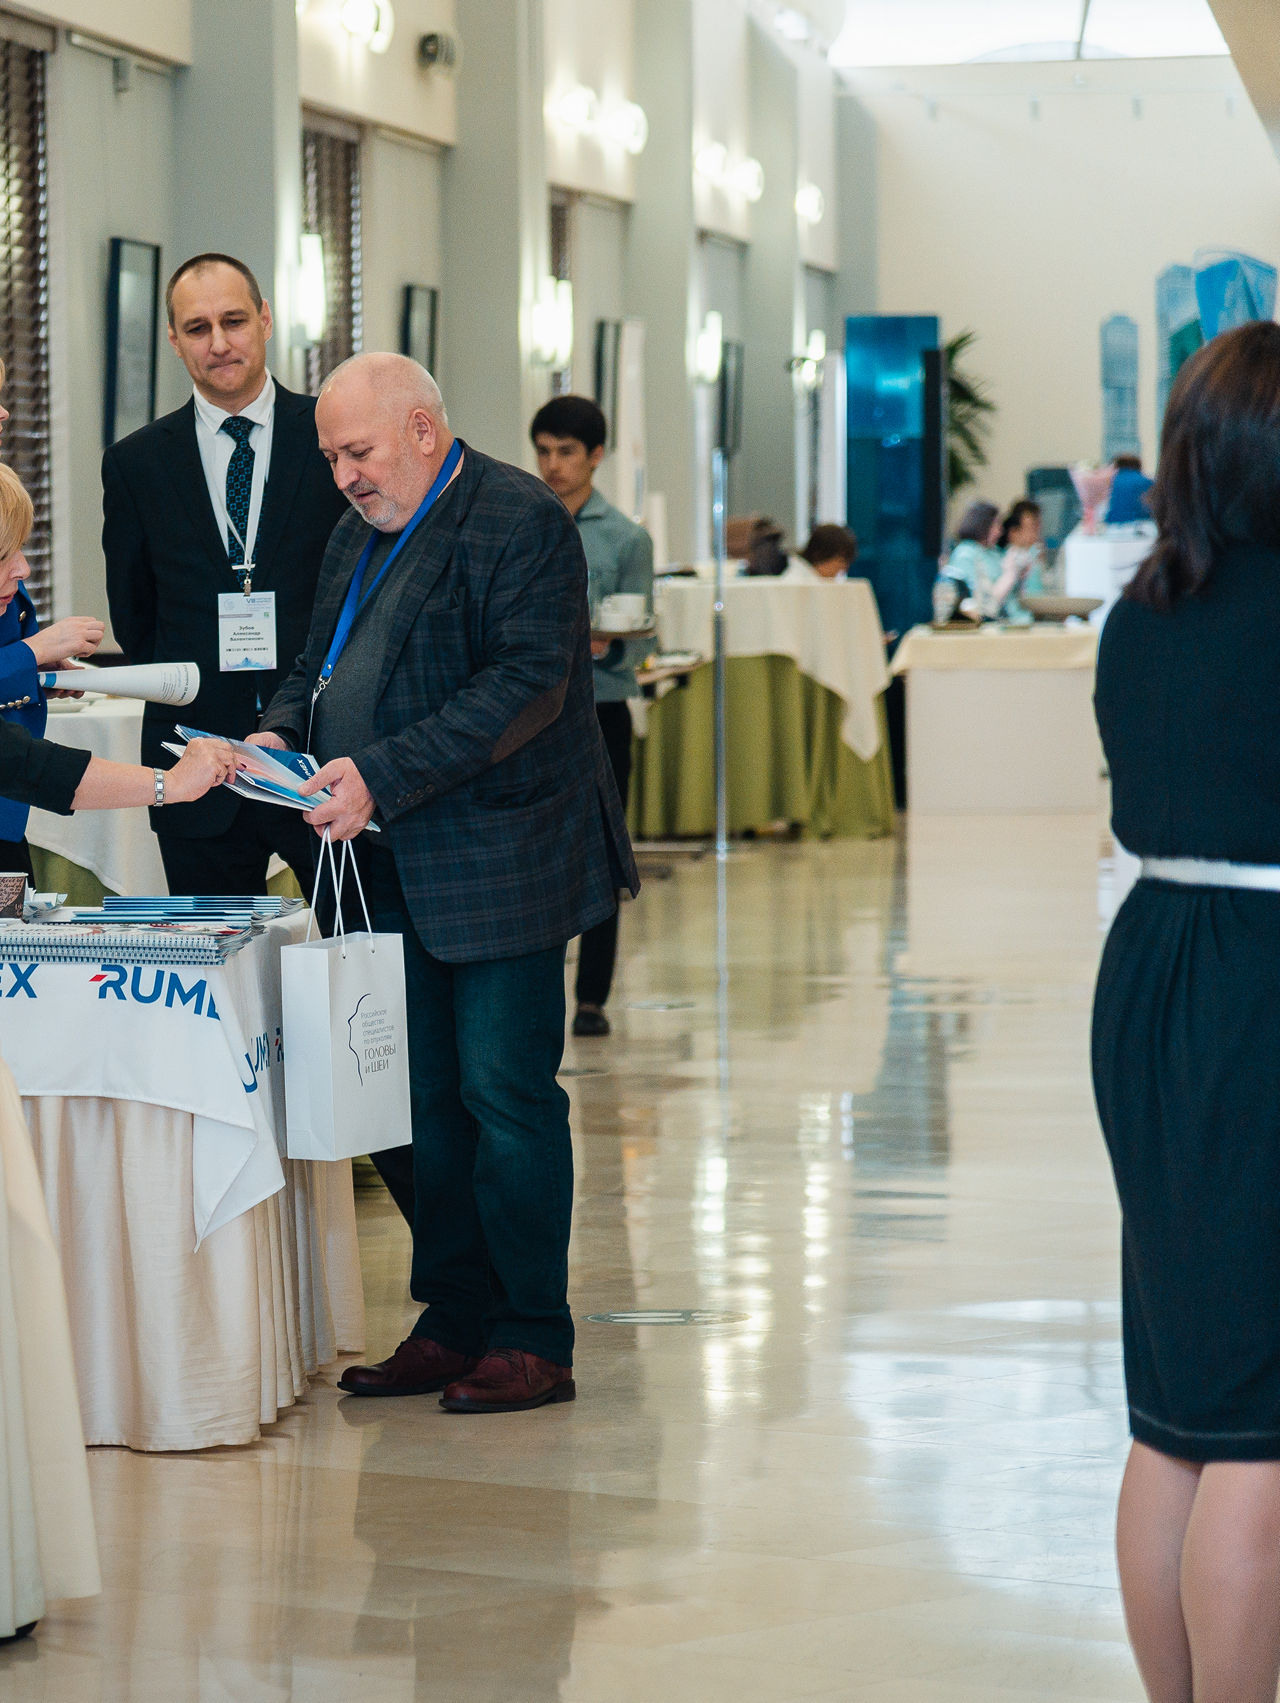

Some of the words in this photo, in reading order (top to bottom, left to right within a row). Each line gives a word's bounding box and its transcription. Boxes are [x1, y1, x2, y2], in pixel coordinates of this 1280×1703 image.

[89, 964, 221, 1021] RUM
[365, 1043, 396, 1060] ГОЛОВЫ
[371, 1059, 389, 1073] ШЕИ
